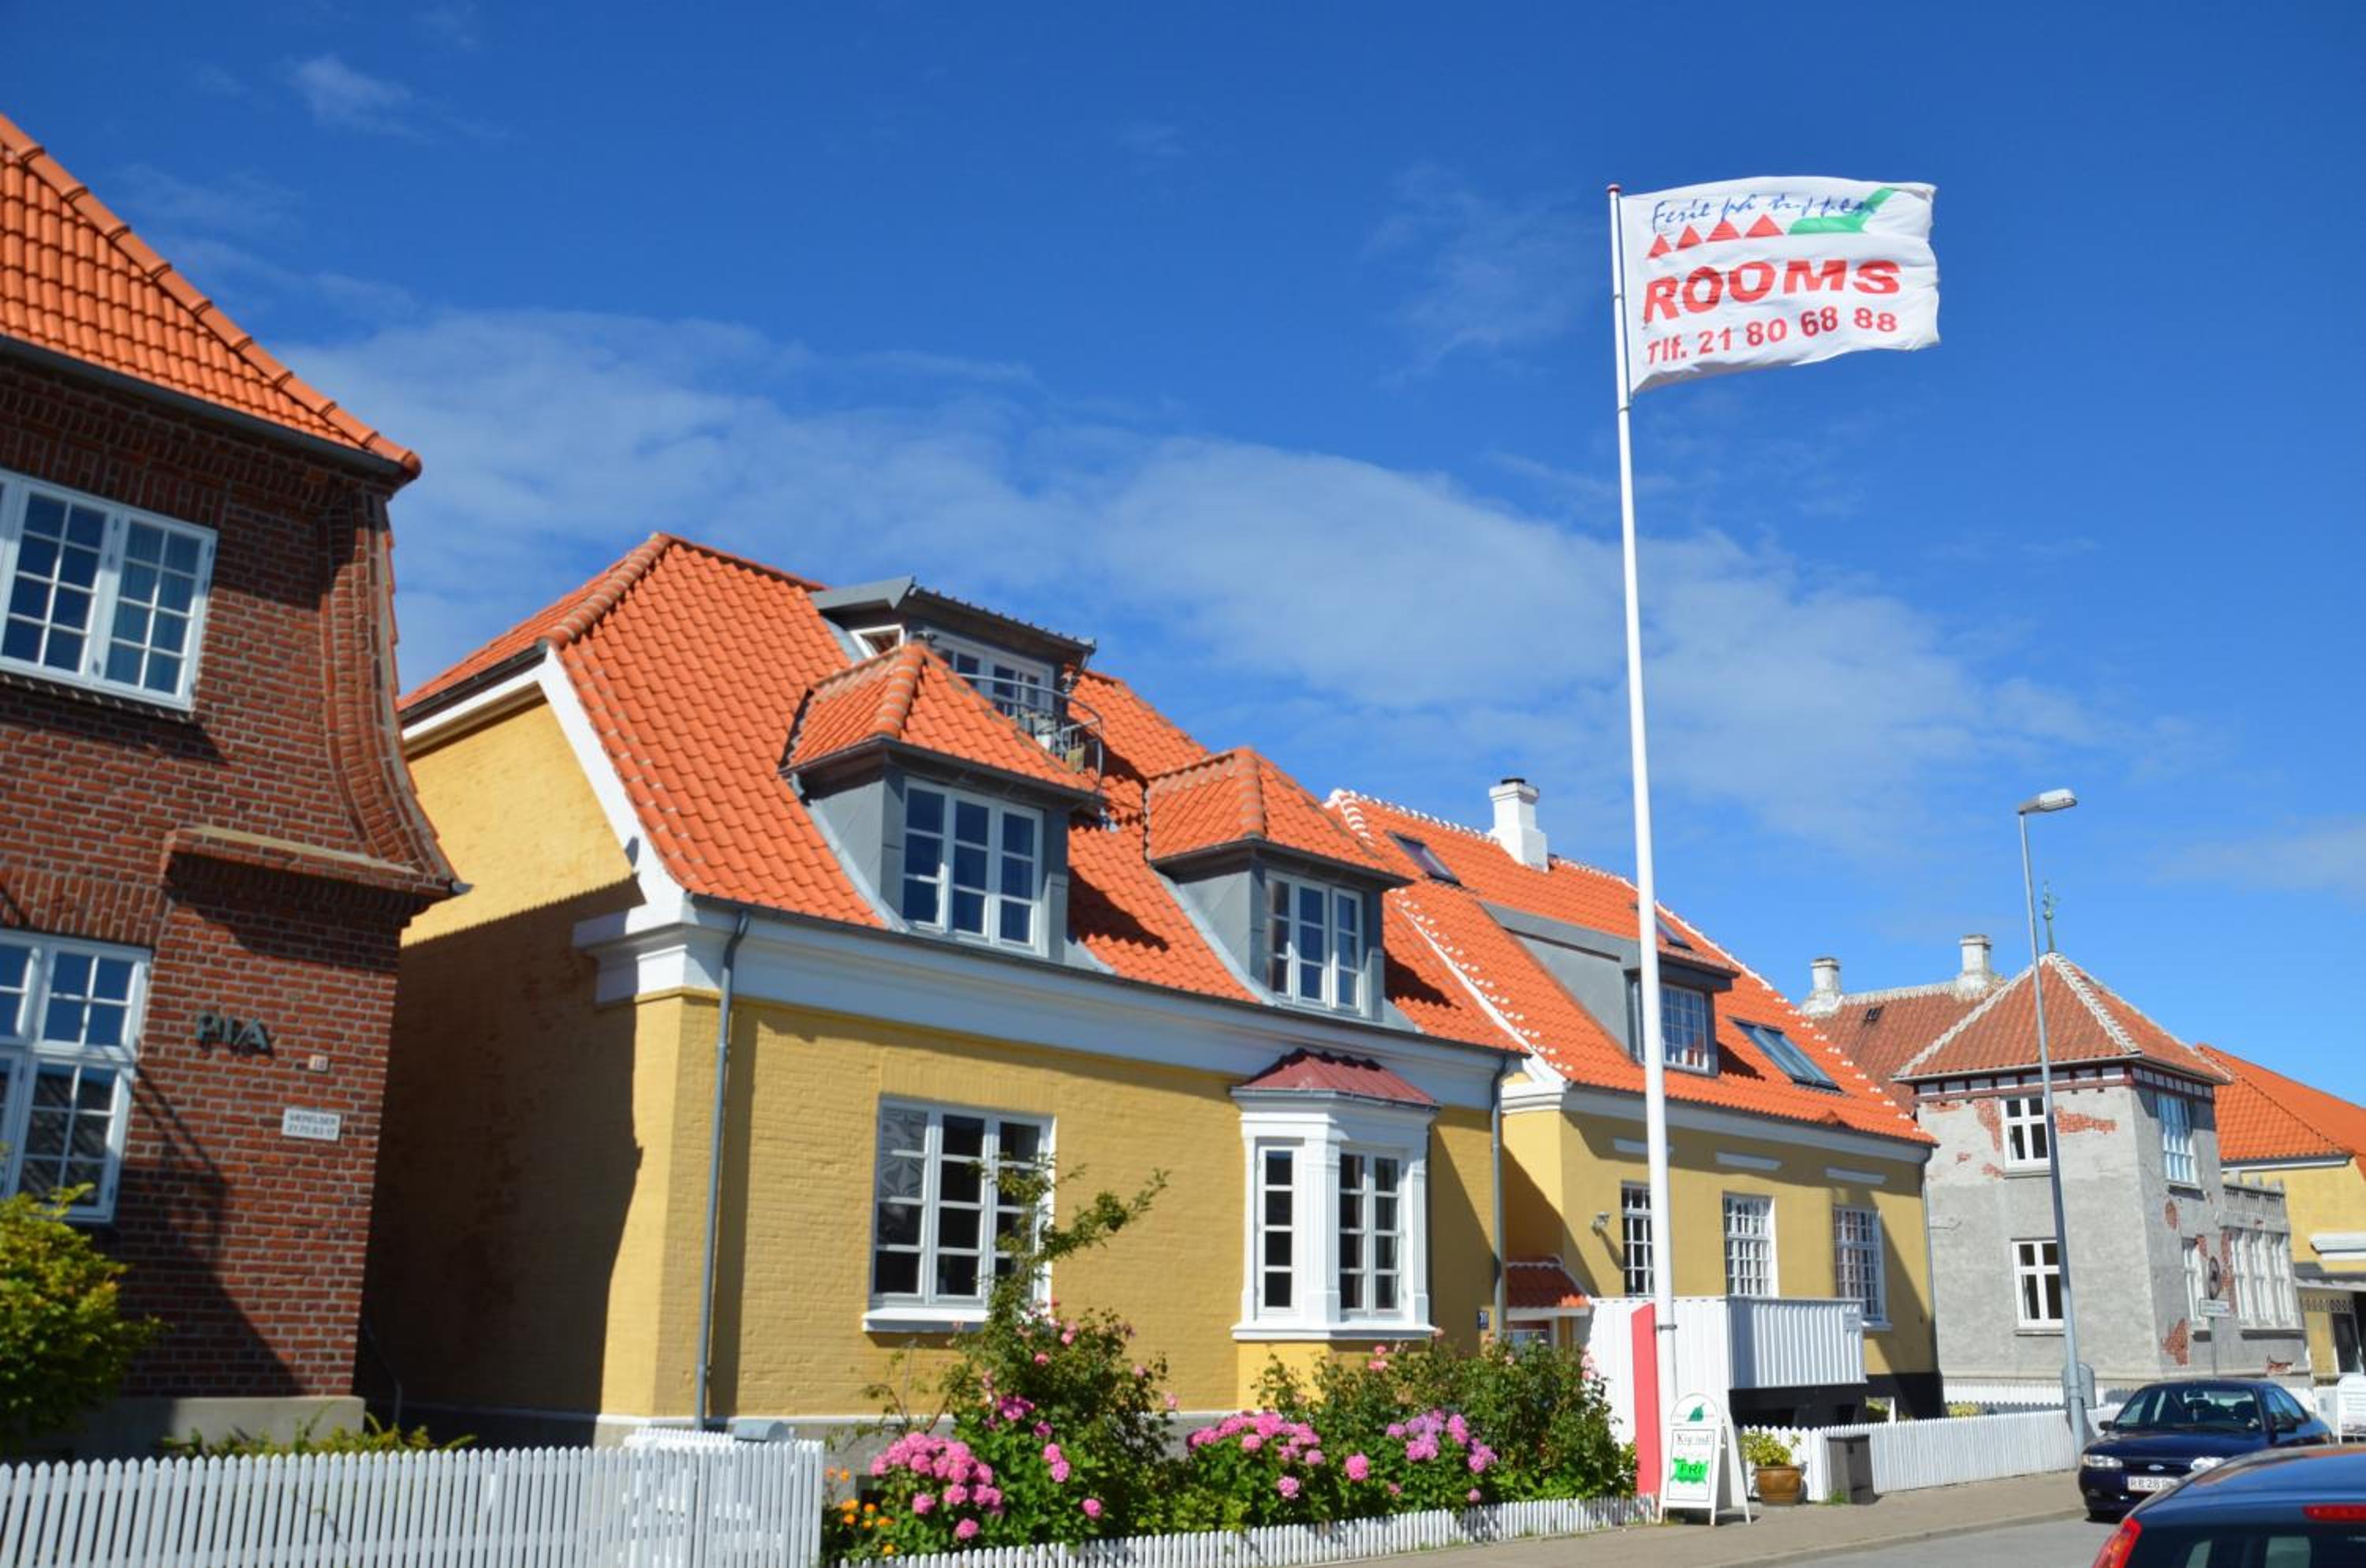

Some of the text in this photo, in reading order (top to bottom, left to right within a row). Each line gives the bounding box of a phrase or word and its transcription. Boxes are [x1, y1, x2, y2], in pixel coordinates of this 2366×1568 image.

[1644, 259, 1901, 324] ROOMS
[1698, 327, 1733, 355] 21
[1746, 319, 1787, 346] 80
[1801, 306, 1838, 337] 68
[1854, 308, 1897, 332] 88
